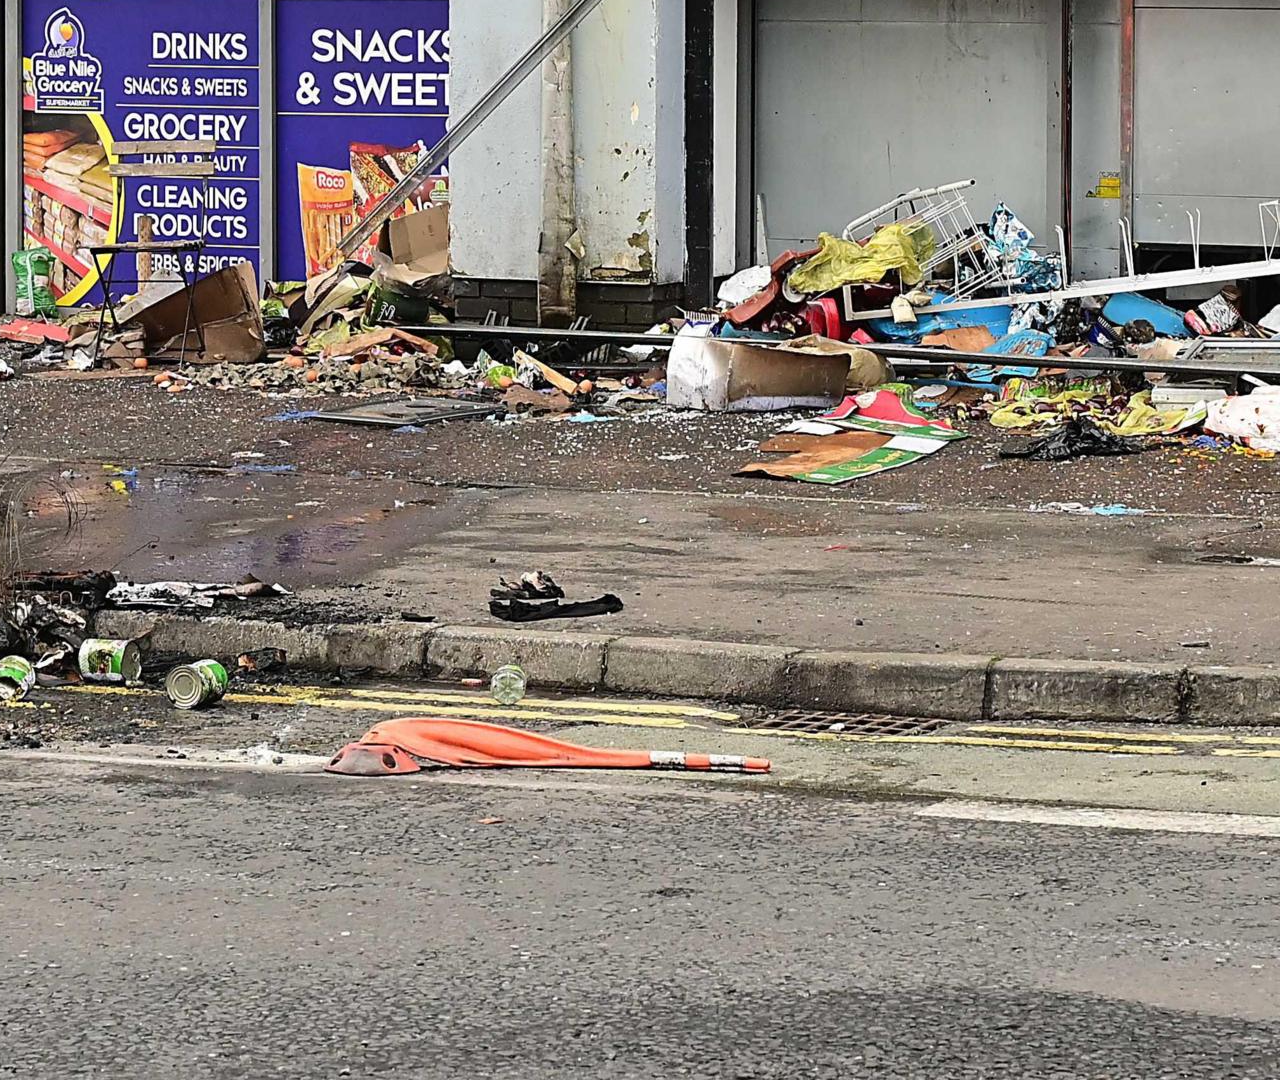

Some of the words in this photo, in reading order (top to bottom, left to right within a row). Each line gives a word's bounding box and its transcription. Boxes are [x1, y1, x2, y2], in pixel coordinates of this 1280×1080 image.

[152, 32, 248, 61] DRINKS
[35, 60, 67, 77] Blue
[69, 60, 97, 77] Nile
[37, 77, 94, 96] Grocery
[123, 77, 179, 95] SNACKS
[181, 77, 191, 95] &
[194, 78, 248, 96] SWEETS
[295, 71, 321, 105] &
[46, 99, 91, 107] SUPERMARKET
[123, 113, 248, 141] GROCERY
[193, 154, 248, 172] BAUTY
[317, 172, 345, 188] Roco
[136, 185, 248, 210] CLEANING
[136, 253, 182, 272] ERBS
[184, 255, 194, 273] &
